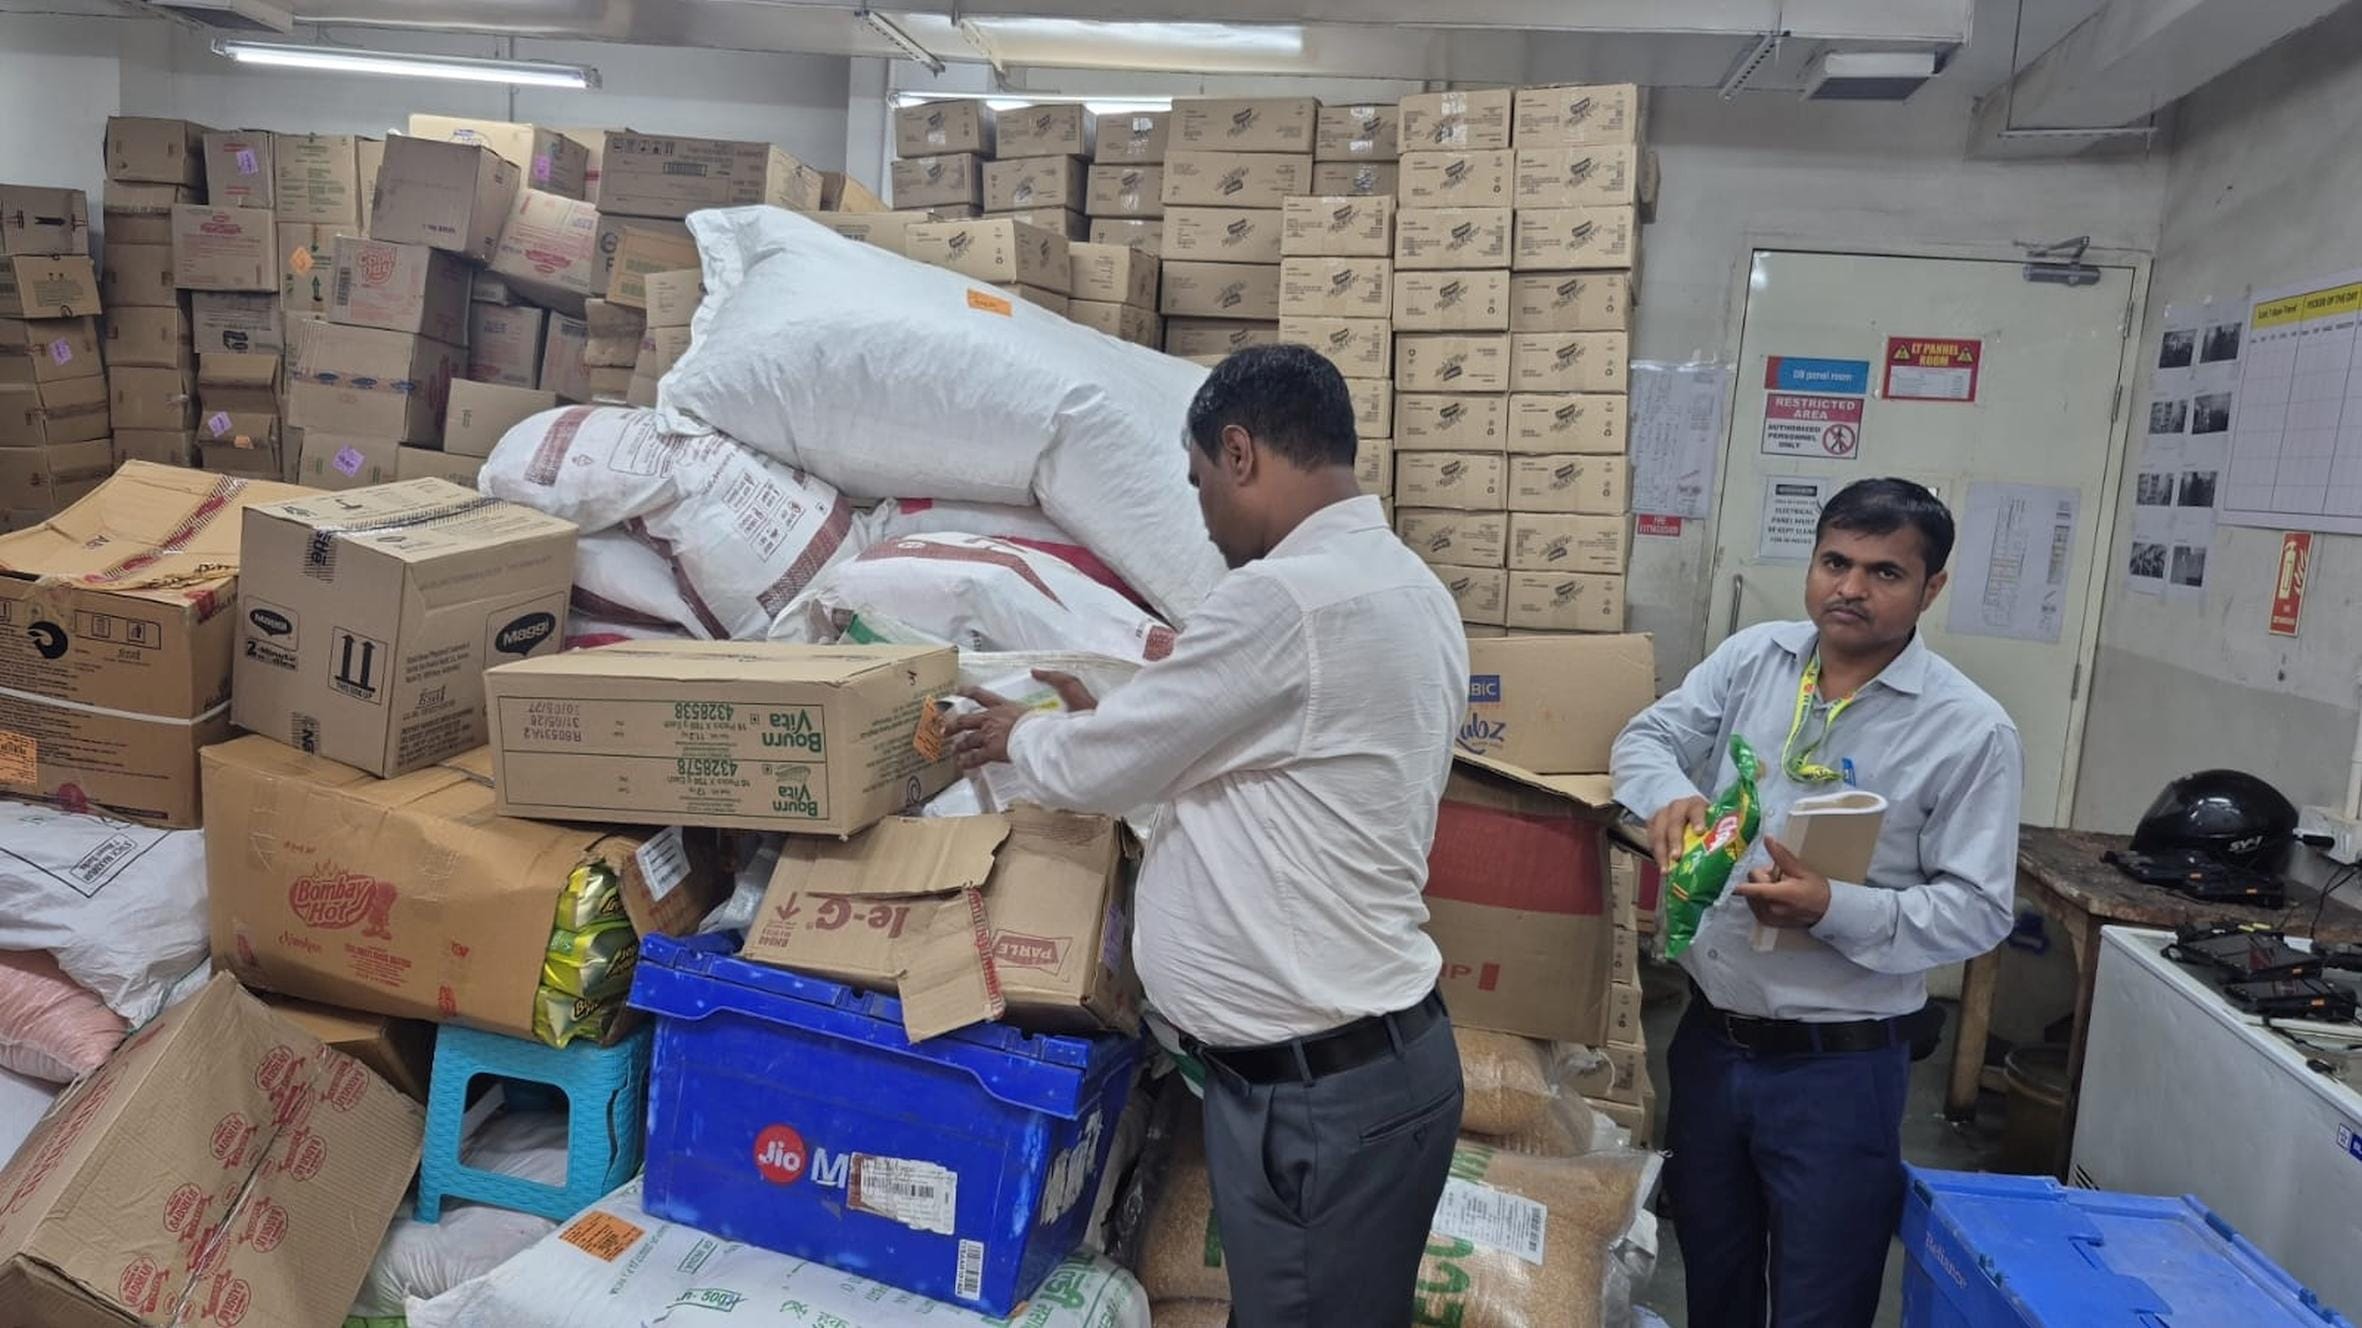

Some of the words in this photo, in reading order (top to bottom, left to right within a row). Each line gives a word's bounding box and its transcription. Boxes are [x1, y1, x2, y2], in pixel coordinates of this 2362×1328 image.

[1775, 397, 1856, 411] RESTRICTED
[1793, 410, 1829, 420] AREA
[1778, 441, 1800, 449] ONLY
[501, 621, 551, 647] Maggi
[674, 702, 735, 721] 4328538
[769, 707, 812, 735] Vita
[761, 731, 823, 753] Bourn
[676, 758, 738, 777] 4328578
[777, 784, 812, 800] Vita
[772, 800, 819, 817] Bourn
[298, 875, 368, 900] Bombay
[309, 902, 348, 922] Hot
[1000, 942, 1054, 960] PARLE
[758, 1139, 801, 1173] Jio
